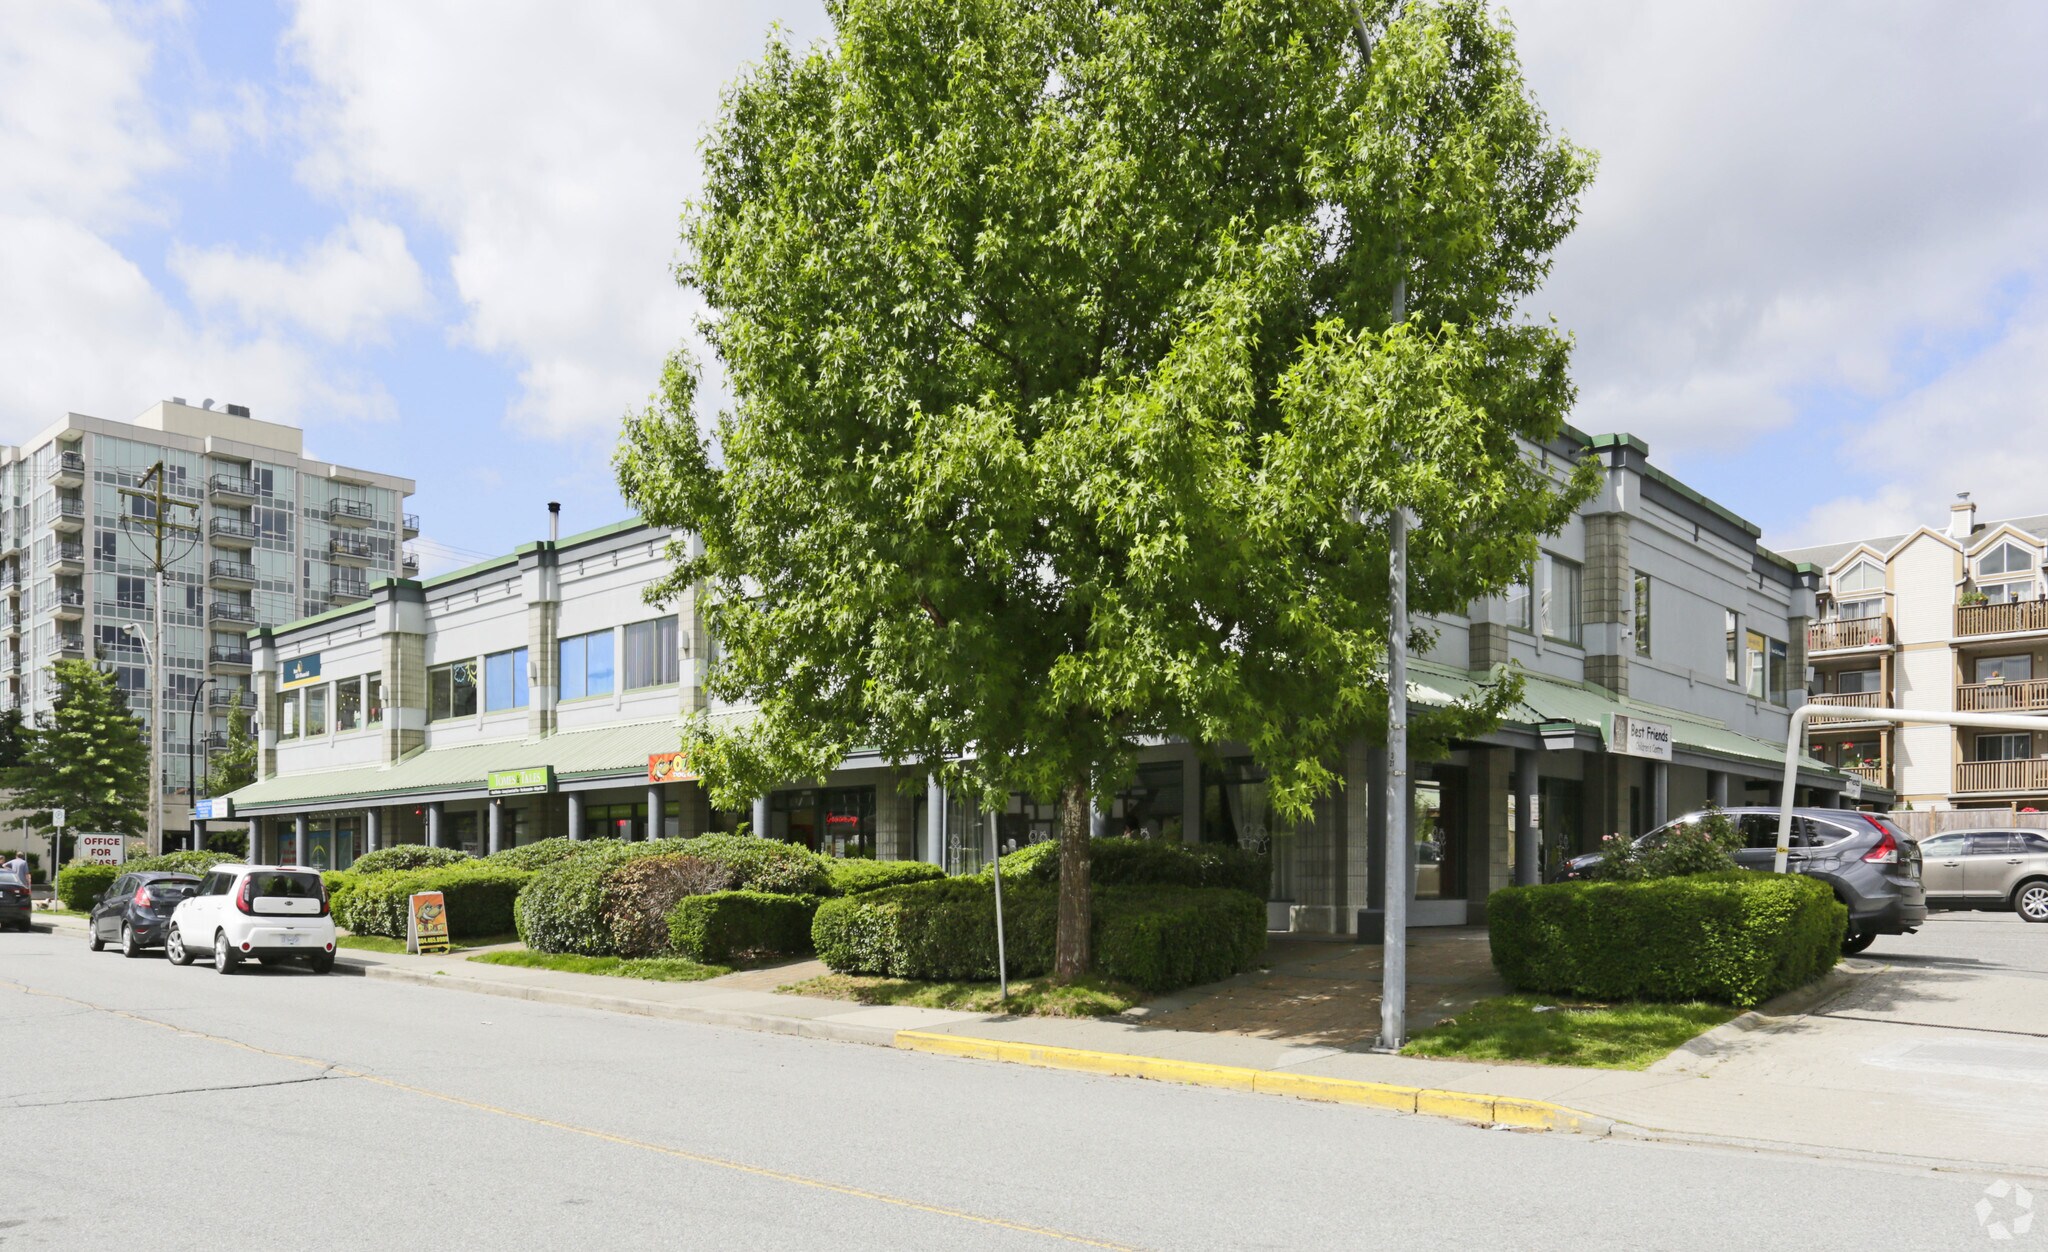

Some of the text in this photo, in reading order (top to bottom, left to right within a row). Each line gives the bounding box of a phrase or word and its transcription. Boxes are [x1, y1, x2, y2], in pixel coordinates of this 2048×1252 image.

[1631, 723, 1668, 743] Best Friends
[494, 774, 516, 787] TOMES
[520, 771, 541, 783] TALES
[826, 811, 858, 828] Grooming
[84, 837, 120, 846] OFFICE
[91, 848, 111, 857] FOR
